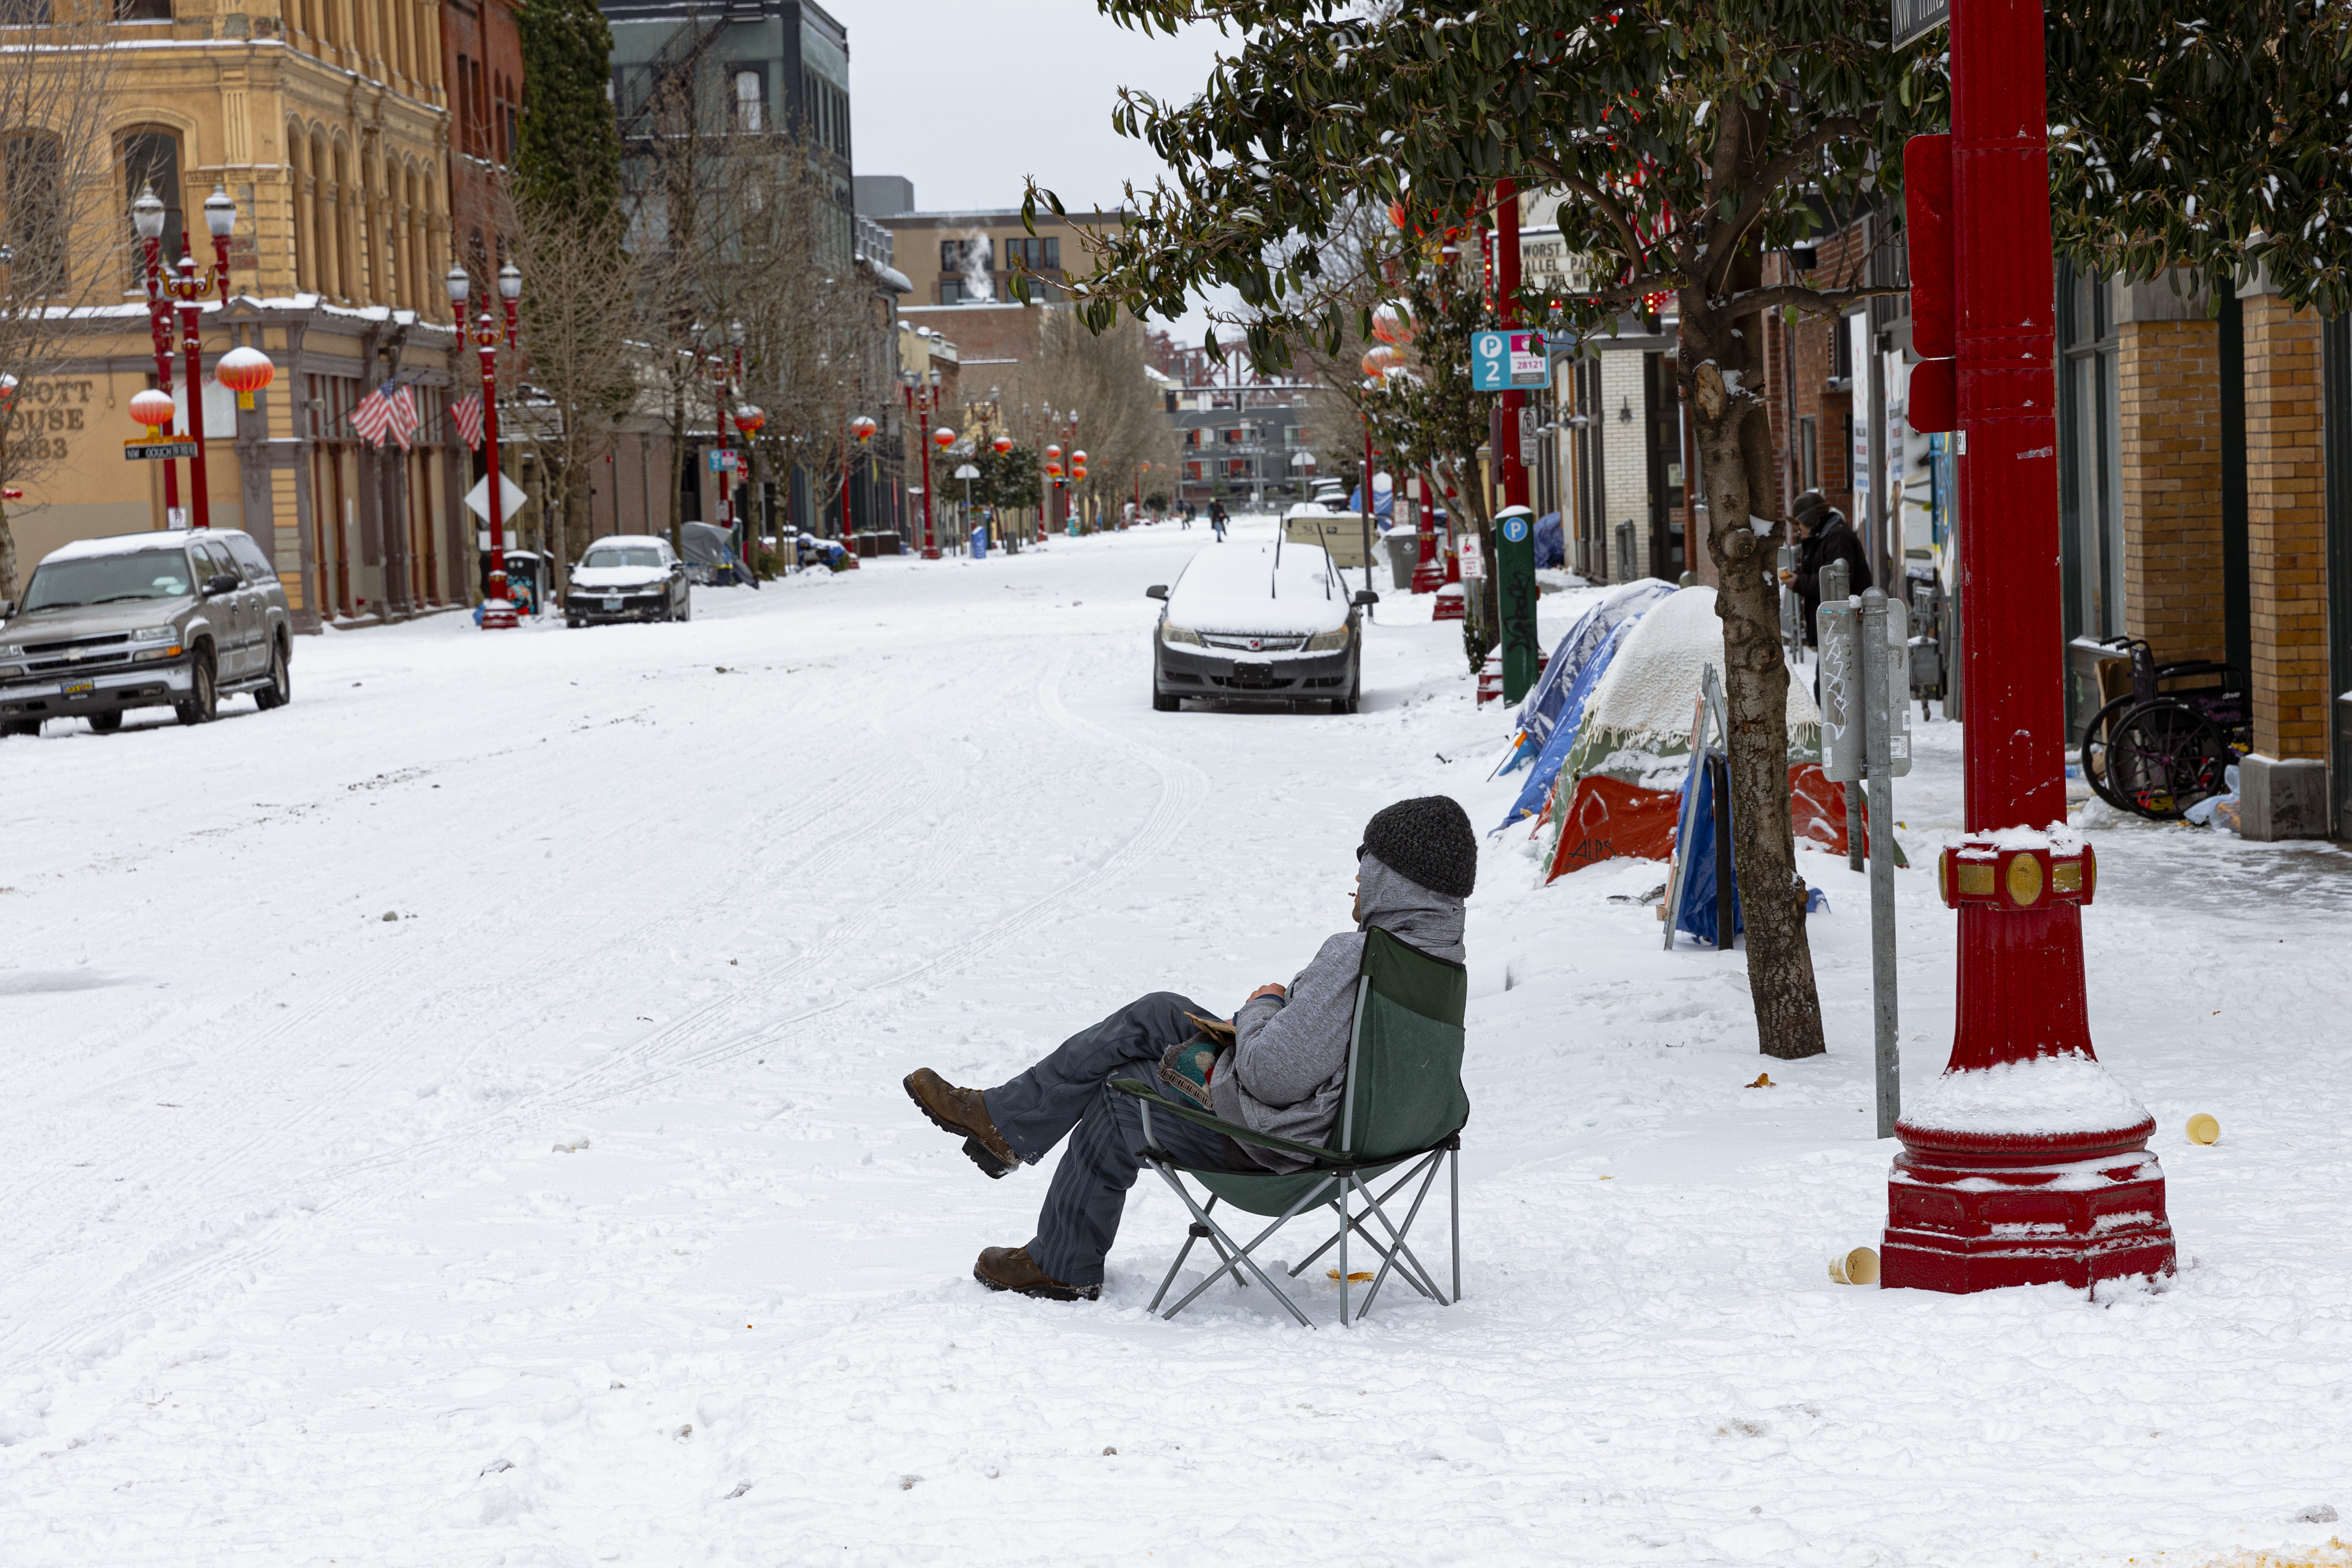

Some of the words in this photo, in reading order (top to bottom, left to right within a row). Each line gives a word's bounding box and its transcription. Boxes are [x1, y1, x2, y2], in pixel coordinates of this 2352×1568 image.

[1523, 243, 1561, 257] WORST
[1520, 258, 1559, 274] ALLEL
[1571, 256, 1600, 271] PAR
[1486, 339, 1497, 354] P
[1486, 361, 1500, 381] 2
[1517, 360, 1543, 369] 28121
[127, 448, 140, 459] NW
[145, 445, 172, 458] COUCH
[1511, 522, 1522, 539] P
[1568, 838, 1618, 861] ALPS
